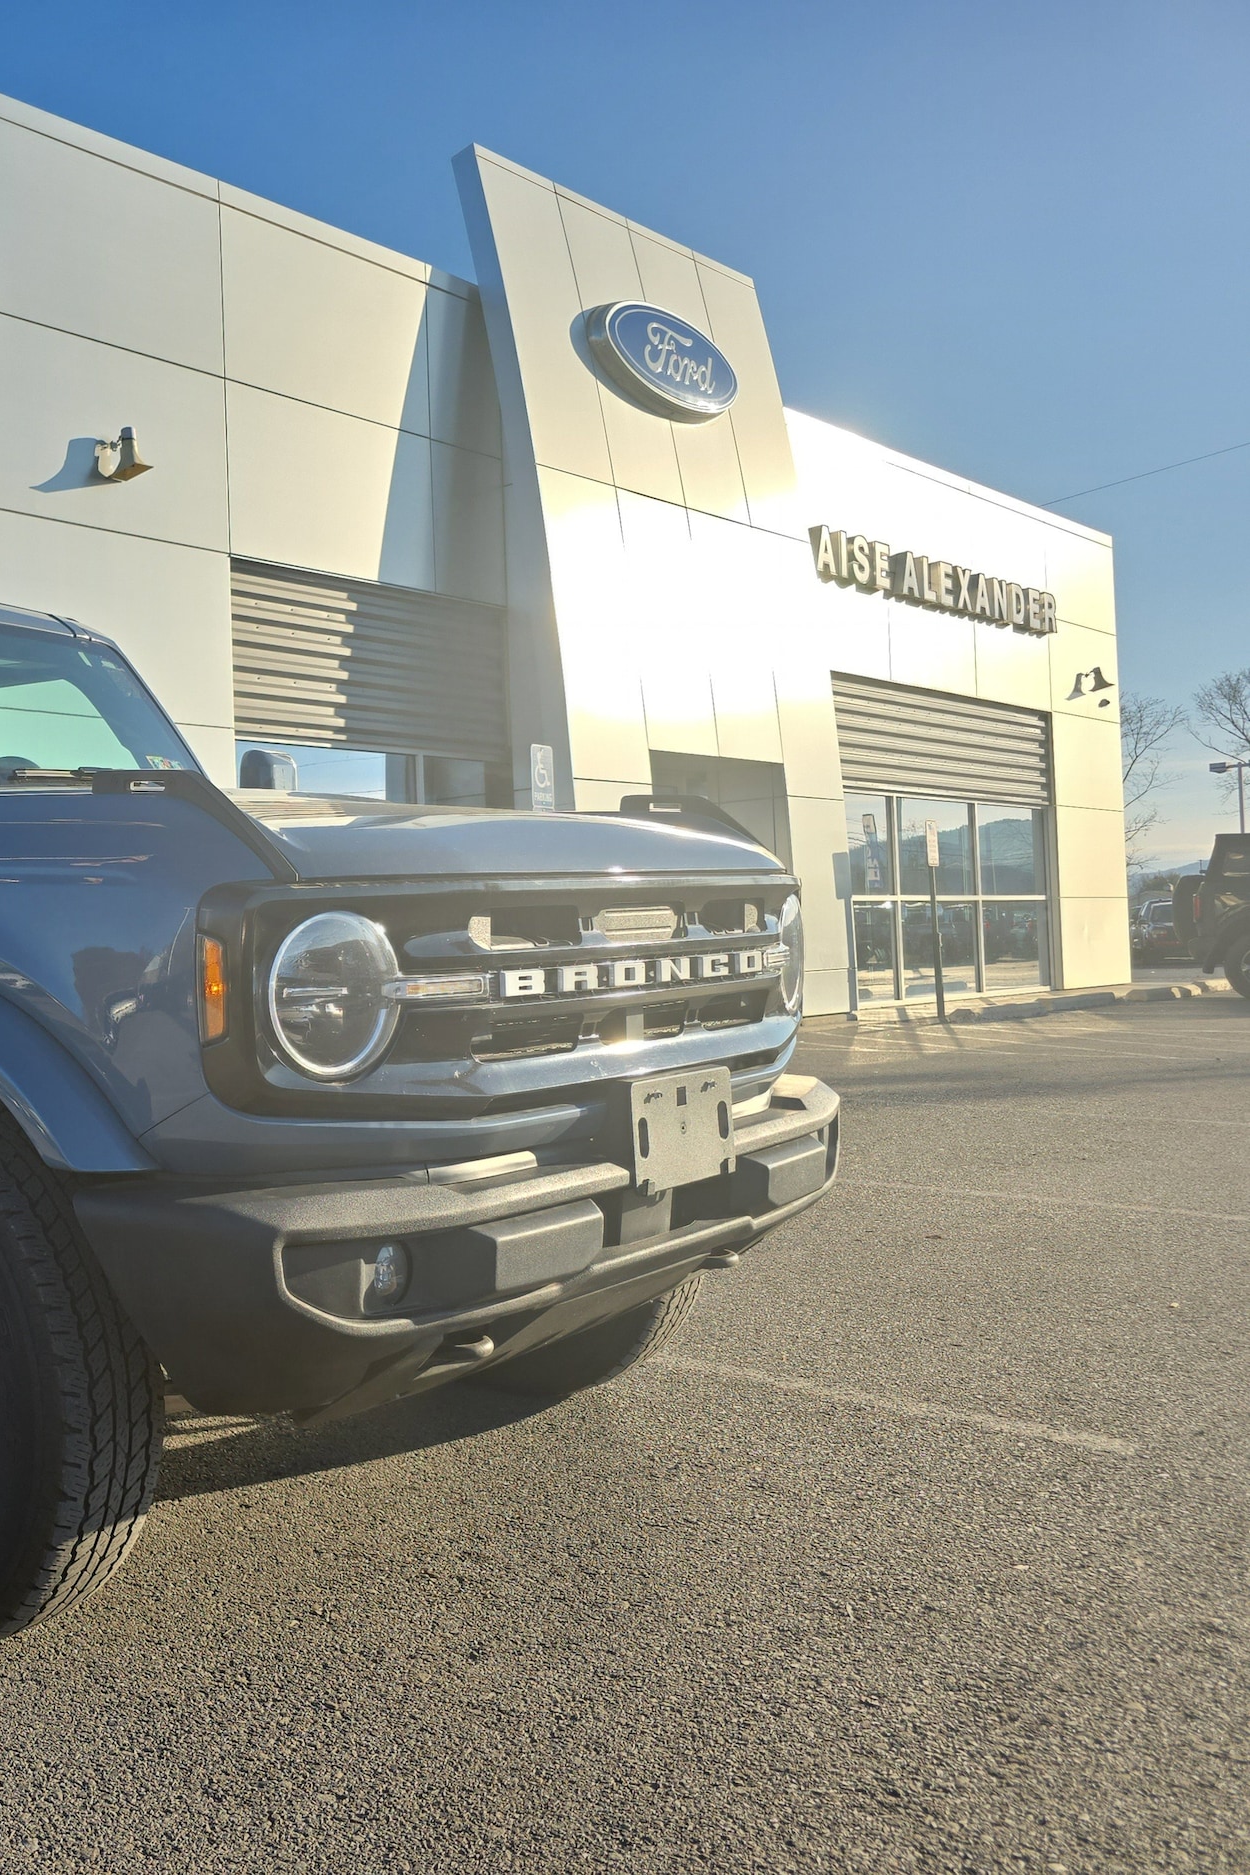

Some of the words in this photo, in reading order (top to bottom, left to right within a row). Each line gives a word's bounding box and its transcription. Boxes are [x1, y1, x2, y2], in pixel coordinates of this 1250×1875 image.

[643, 321, 716, 395] Ford
[810, 524, 891, 590] AISE
[900, 550, 1058, 634] ALEXANDER
[534, 792, 553, 802] PARKING
[501, 950, 763, 998] BRONCO
